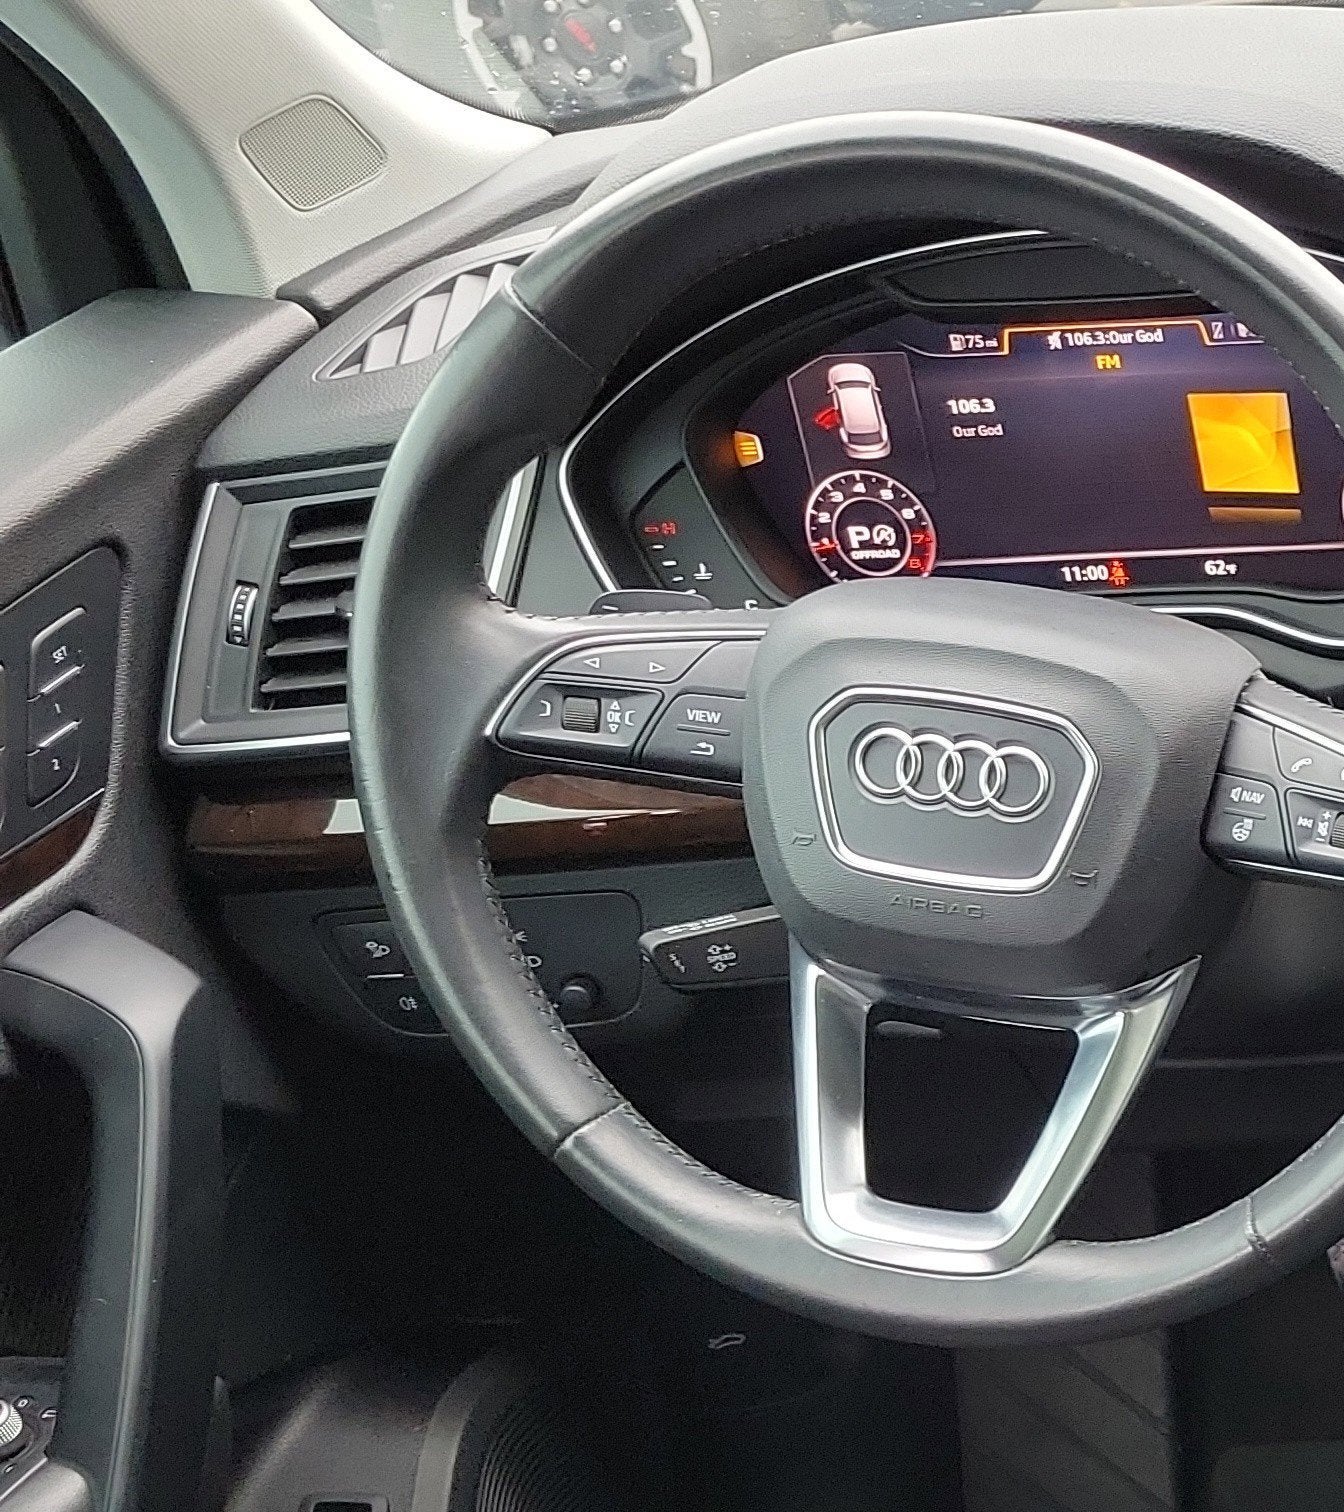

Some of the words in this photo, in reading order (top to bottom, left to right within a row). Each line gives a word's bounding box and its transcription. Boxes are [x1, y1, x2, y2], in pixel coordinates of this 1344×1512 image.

[964, 335, 985, 348] 75
[1135, 328, 1164, 343] God
[1095, 354, 1122, 369] FM
[952, 426, 977, 438] Our
[977, 424, 1004, 437] God
[852, 482, 866, 493] 4
[828, 491, 844, 502] 3
[879, 489, 895, 500] 5
[818, 512, 831, 523] 2
[900, 508, 916, 520] 6
[846, 525, 871, 548] P
[849, 549, 901, 560] OFFROAD
[1060, 564, 1109, 582] 11:00
[606, 711, 622, 723] OK
[686, 708, 722, 724] VIEW
[1242, 791, 1266, 805] NAV
